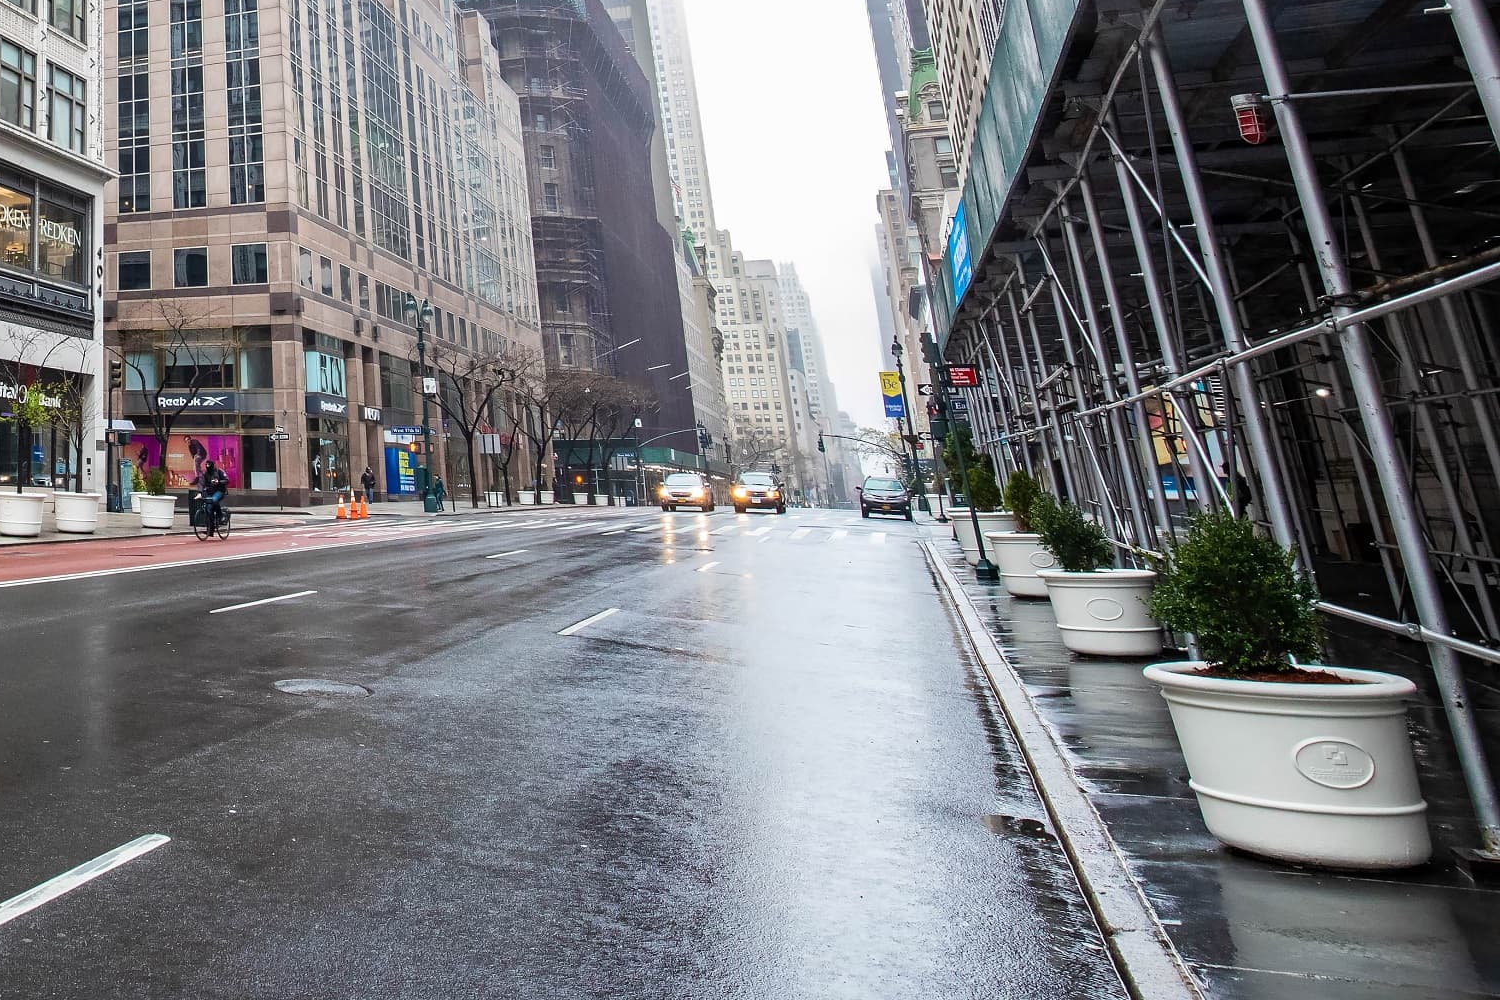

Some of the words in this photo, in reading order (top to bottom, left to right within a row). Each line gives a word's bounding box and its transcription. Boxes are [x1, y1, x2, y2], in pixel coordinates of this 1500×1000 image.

[40, 218, 82, 247] REDKEN
[882, 378, 898, 390] Be
[38, 393, 62, 408] Bank
